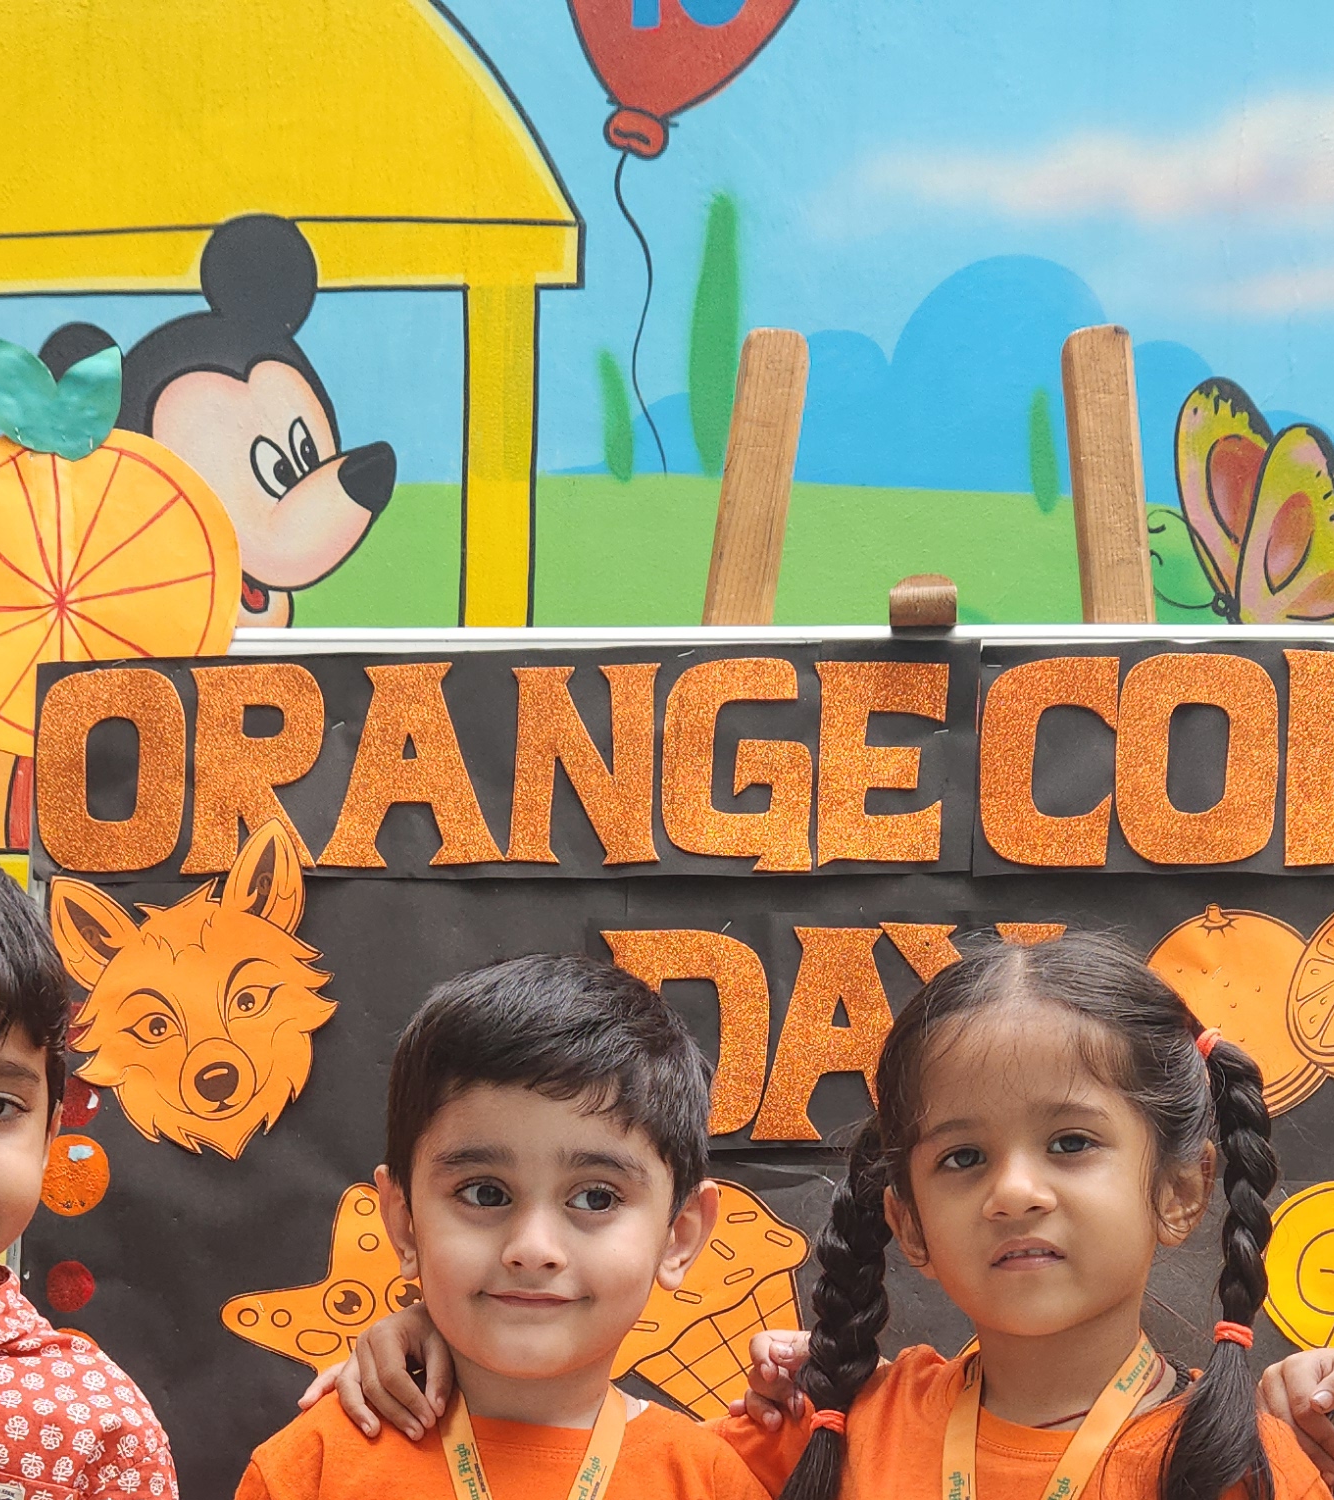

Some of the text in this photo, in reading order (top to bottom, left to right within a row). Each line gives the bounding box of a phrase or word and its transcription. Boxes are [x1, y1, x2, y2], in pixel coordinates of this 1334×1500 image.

[35, 658, 649, 874] ORANGE
[453, 1443, 473, 1477] High
[580, 1456, 602, 1486] High
